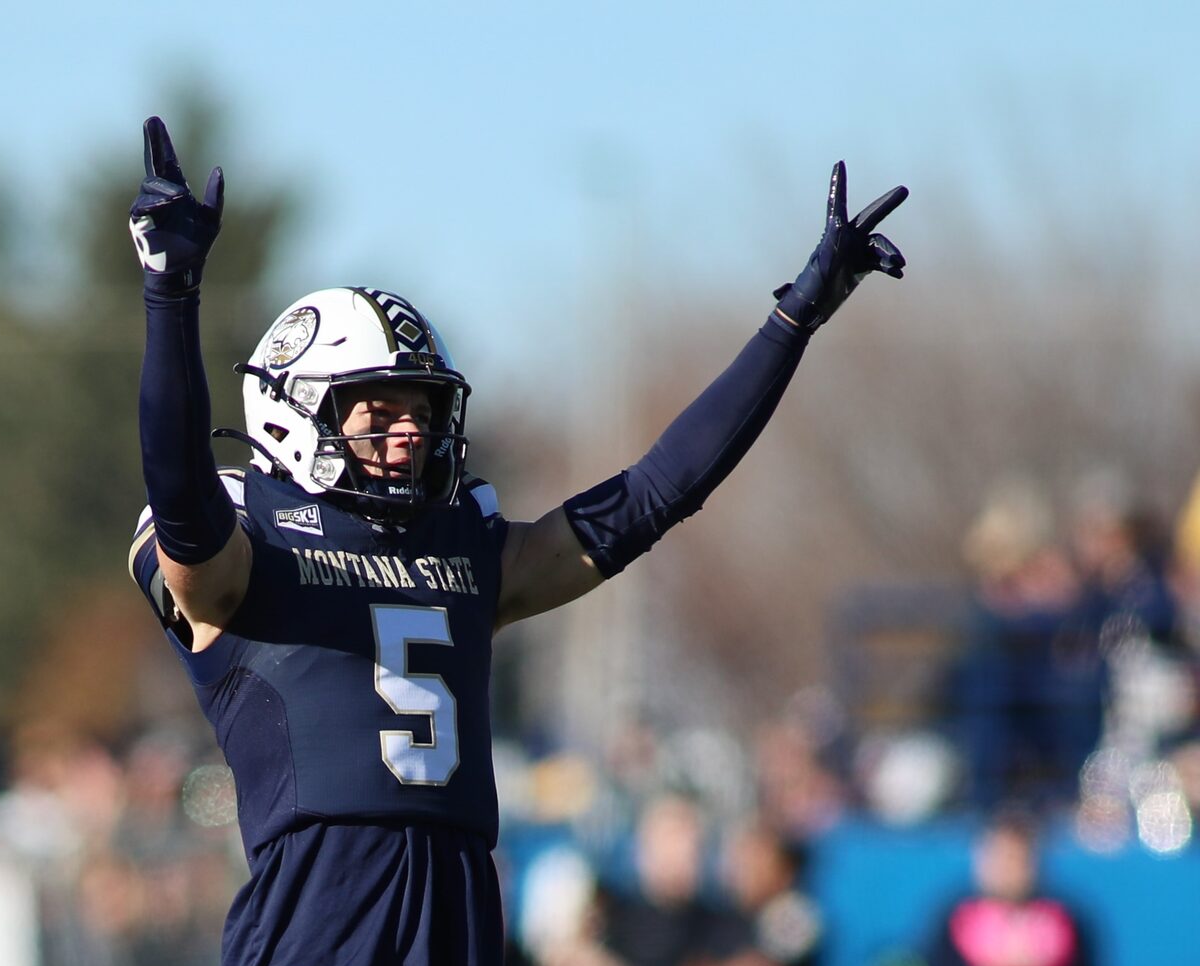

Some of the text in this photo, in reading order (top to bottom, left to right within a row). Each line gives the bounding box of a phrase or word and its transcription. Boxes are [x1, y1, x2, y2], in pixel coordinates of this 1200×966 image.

[292, 548, 480, 595] MONTANA STATE
[369, 603, 460, 787] 5
